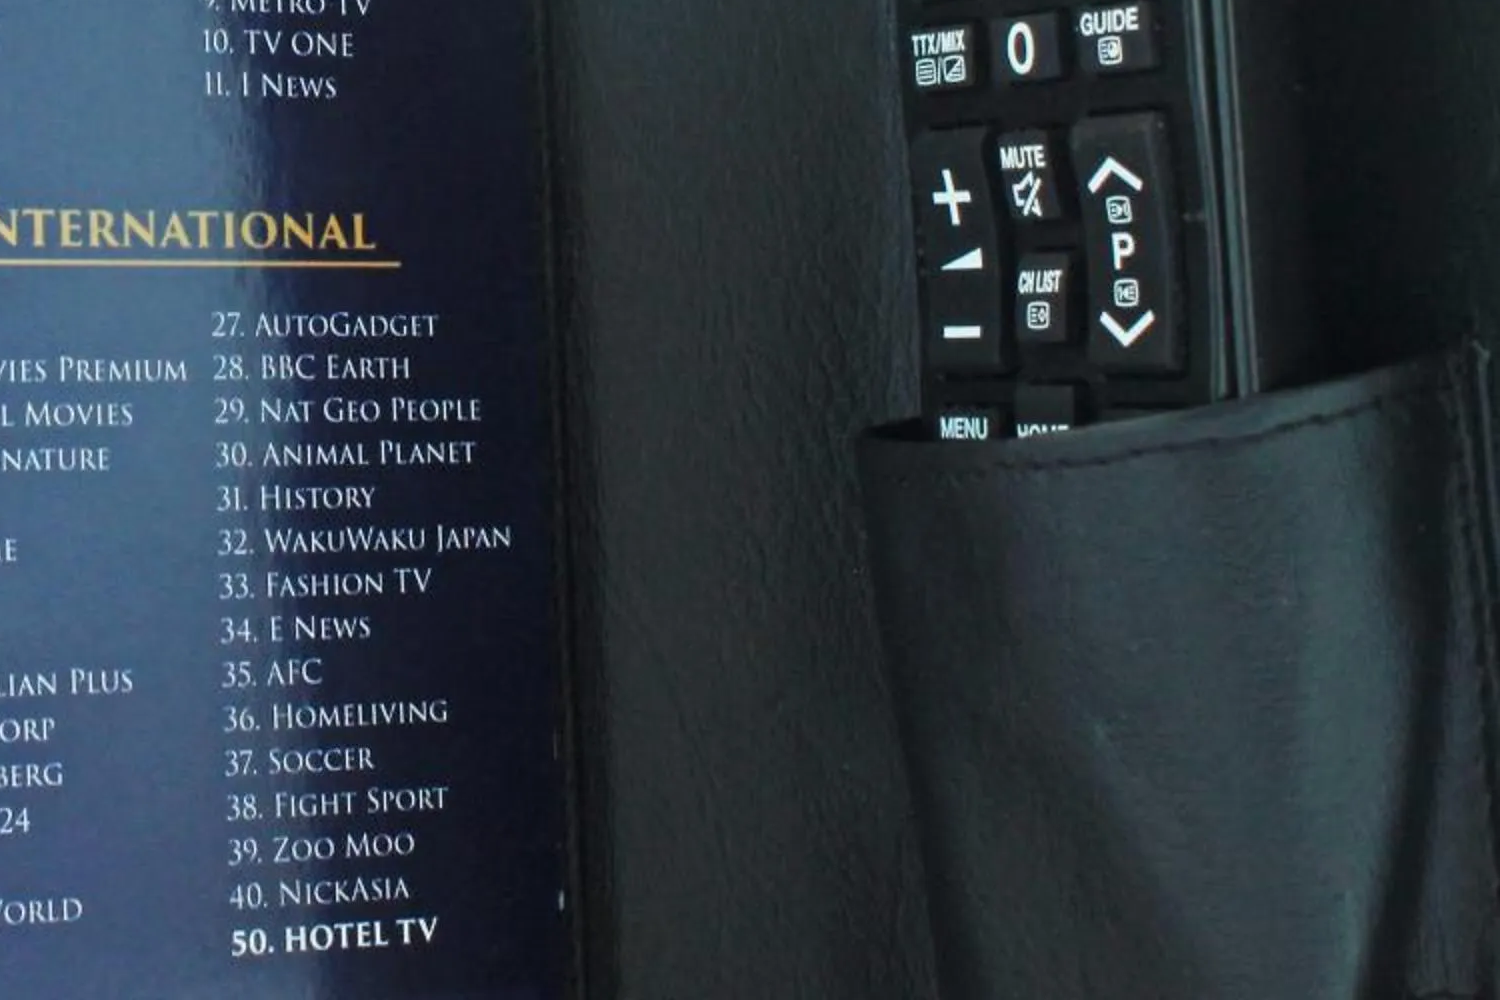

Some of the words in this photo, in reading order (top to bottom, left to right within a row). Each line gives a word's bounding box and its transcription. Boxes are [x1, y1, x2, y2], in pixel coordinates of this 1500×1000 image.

[1079, 7, 1140, 37] GUIDE
[201, 28, 234, 55] 10.
[243, 29, 281, 56] TV
[291, 31, 355, 58] ONE
[911, 29, 966, 56] TTX/MIX
[1007, 22, 1035, 75] 0
[203, 71, 231, 98] 11.
[241, 71, 250, 98] I
[260, 73, 337, 99] NEWS
[999, 144, 1046, 170] MUTE
[1112, 232, 1136, 270] P
[1017, 272, 1035, 293] CH
[1036, 269, 1063, 293] LIST
[211, 312, 245, 338] 27.
[255, 312, 440, 338] AUTOGADGET
[59, 356, 188, 383] PREMIUM
[213, 355, 249, 381] 28.
[260, 354, 315, 381] BBC
[326, 355, 411, 380] EARTH
[24, 402, 134, 427] MOVIES
[214, 398, 250, 425] 29.
[260, 398, 315, 423] NAT
[323, 398, 380, 423] GEO
[391, 398, 482, 423] PEOPLE
[940, 417, 989, 440] MENU
[215, 442, 253, 468] 30.
[263, 442, 370, 467] ANIMAL
[380, 440, 477, 465] PLANET
[216, 486, 248, 512] 31.
[260, 485, 376, 510] HISTORY
[217, 530, 254, 556] 32.
[264, 526, 426, 554] WAKUWAKU
[436, 524, 513, 553] JAPAN
[219, 573, 255, 600] 33.
[266, 571, 383, 598] FASHION
[393, 568, 433, 594] TV
[220, 617, 257, 644] 34.
[271, 617, 283, 641] E
[295, 615, 371, 640] NEWS
[69, 669, 134, 695] PLUS
[221, 662, 257, 689] 35.
[267, 658, 324, 686] AFC
[223, 706, 260, 732] 36.
[272, 700, 448, 730] HOMELIVING
[225, 750, 257, 777] 37.
[269, 748, 376, 775] SOCCER
[227, 795, 263, 822] 38.
[274, 792, 357, 818] FIGHT
[366, 786, 449, 814] SPORT
[228, 839, 262, 866] 39.
[273, 838, 334, 863] ZOO
[345, 832, 415, 859] MOO
[229, 883, 267, 910] 40.
[278, 877, 410, 906] NICKASIA
[231, 930, 274, 957] 50.
[284, 921, 389, 953] HOTEL
[395, 916, 439, 944] TV
